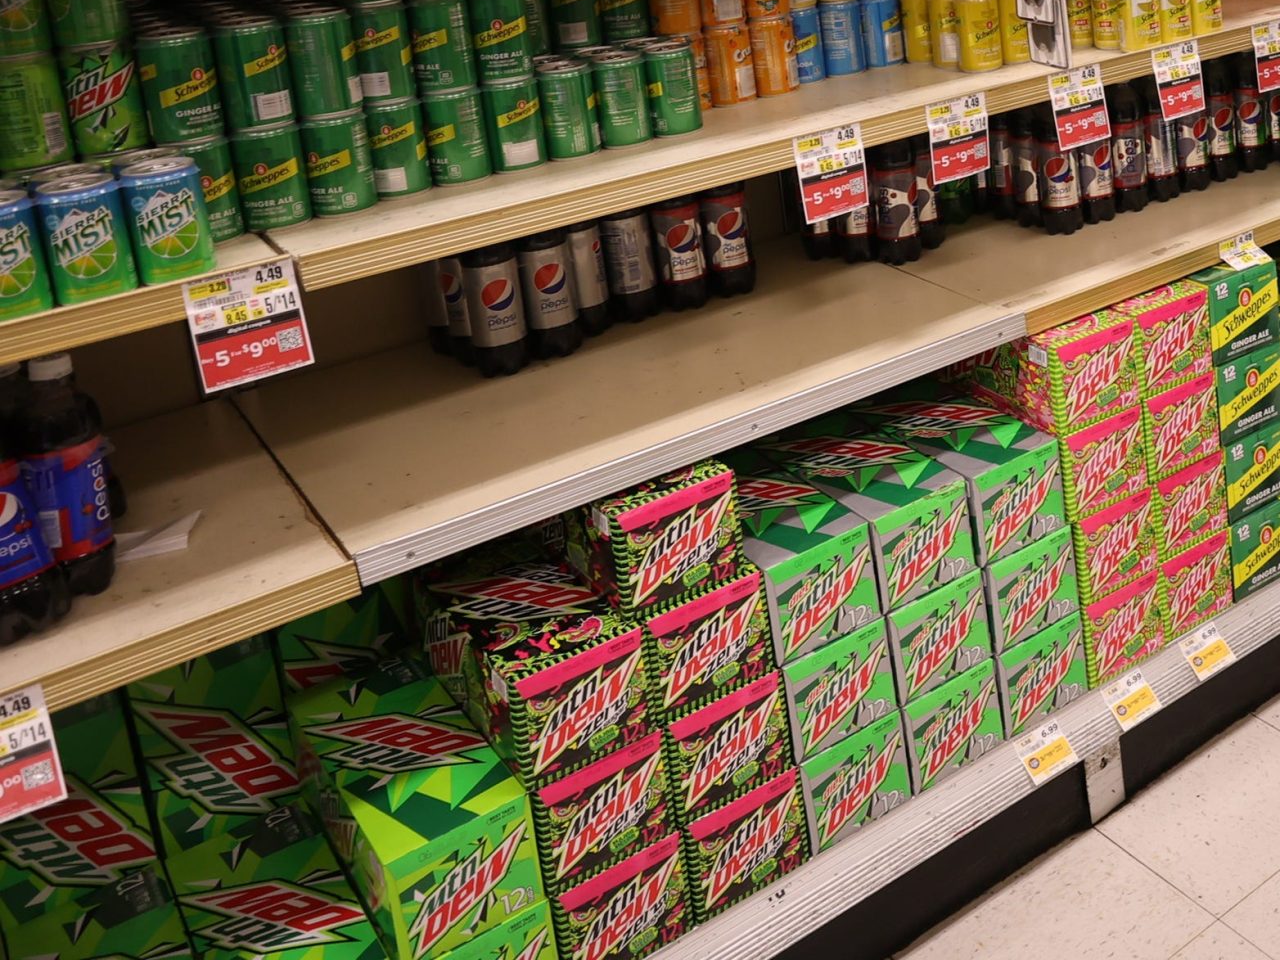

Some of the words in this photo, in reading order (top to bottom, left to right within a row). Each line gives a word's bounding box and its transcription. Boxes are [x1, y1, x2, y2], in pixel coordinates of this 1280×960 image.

[479, 22, 525, 47] Schweppes
[480, 52, 507, 61] GINGER
[509, 50, 523, 59] ALE
[1082, 68, 1096, 80] 4.49
[964, 98, 980, 109] 4.49
[837, 128, 855, 141] 4.49
[138, 189, 188, 224] SIERRA
[276, 196, 293, 204] ALE
[814, 192, 823, 205] 5
[51, 208, 107, 240] SIERRA
[140, 192, 193, 242] MIST
[53, 215, 113, 263] MIST
[255, 266, 283, 283] 4.49
[1215, 282, 1228, 295] 12
[226, 311, 247, 325] 8.45
[1223, 289, 1272, 340] Schweppes
[227, 325, 248, 334] digital
[249, 320, 272, 329] coupon
[1231, 333, 1256, 350] GINGER
[1257, 329, 1269, 339] ALE
[215, 350, 230, 367] 5
[1223, 366, 1236, 378] 12
[1120, 392, 1134, 406] 12
[1231, 369, 1278, 418] Schweppes
[1237, 410, 1263, 428] GINGER
[1263, 405, 1275, 415] ALE
[88, 459, 110, 520] pepsi
[0, 535, 32, 557] epsi
[848, 605, 866, 627] 12
[1201, 627, 1216, 640] 6.99
[966, 646, 981, 666] 12
[1127, 672, 1142, 687] 6.99
[1041, 723, 1058, 738] 6.99
[501, 886, 525, 916] 12
